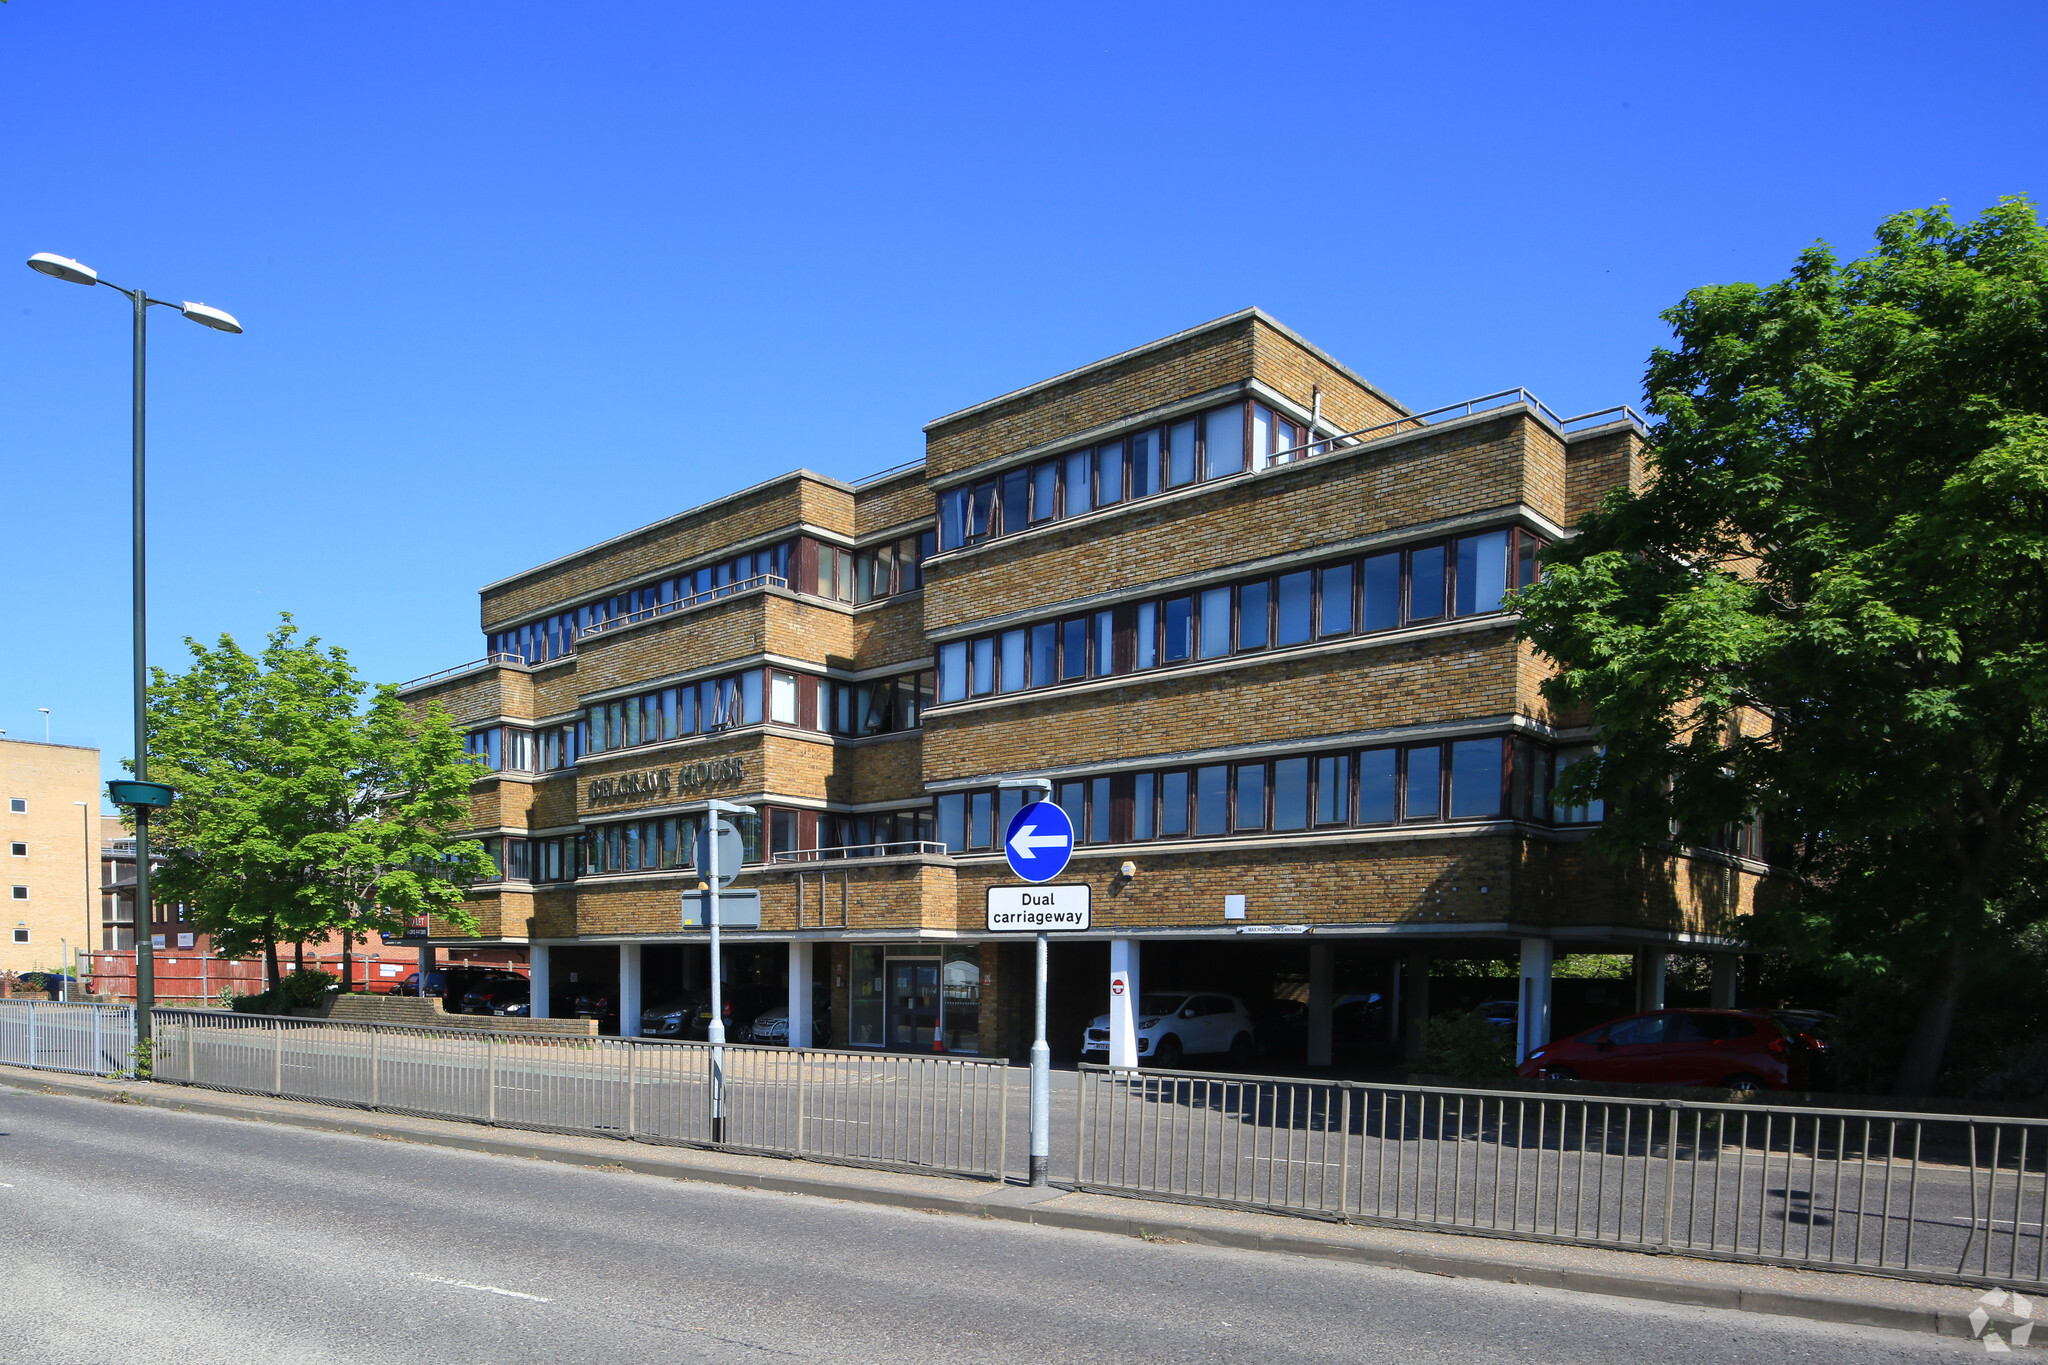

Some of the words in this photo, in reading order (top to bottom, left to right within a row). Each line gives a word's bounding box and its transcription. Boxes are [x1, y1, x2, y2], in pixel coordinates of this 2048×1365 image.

[591, 767, 672, 799] BELGRAVE
[682, 756, 745, 786] HOUSE
[1022, 893, 1055, 906] Dual
[415, 917, 425, 926] LET
[993, 910, 1083, 925] carriageway
